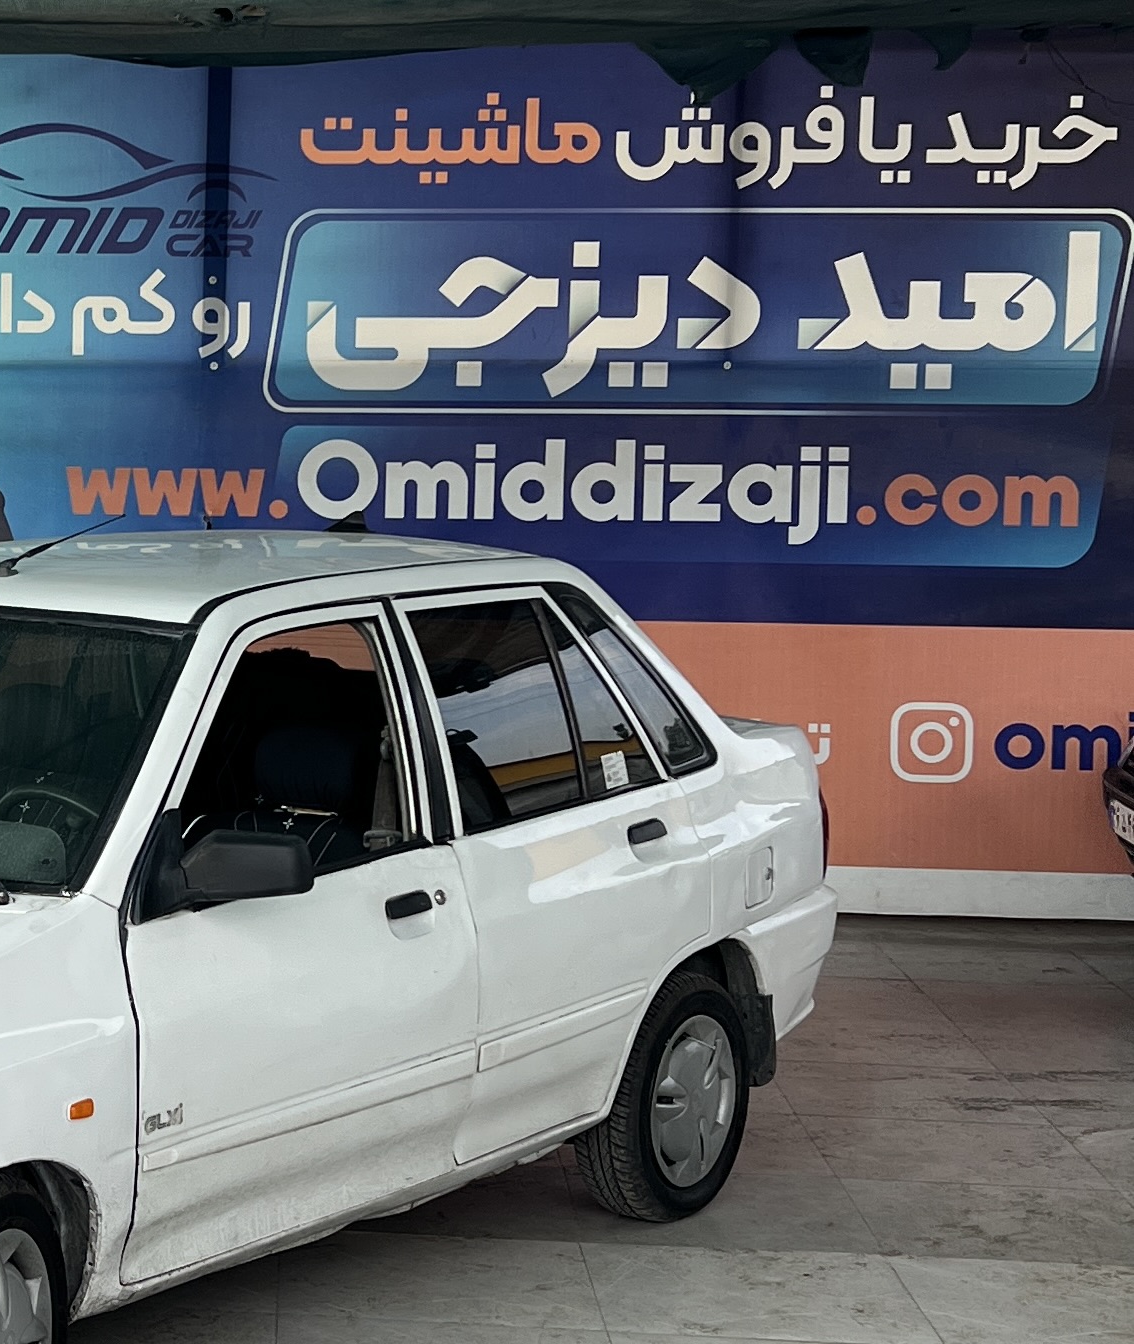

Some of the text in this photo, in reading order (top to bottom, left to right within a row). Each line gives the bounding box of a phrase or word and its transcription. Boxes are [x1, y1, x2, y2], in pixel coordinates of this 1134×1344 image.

[300, 85, 1118, 190] خرید یا فروش ماشینت
[166, 234, 254, 257] CAR
[168, 209, 263, 229] DIZAJI
[71, 268, 175, 357] کم
[191, 296, 251, 359] رو
[307, 231, 1101, 398] امید دیزجی
[67, 439, 1080, 545] www.Omiddizaji.com
